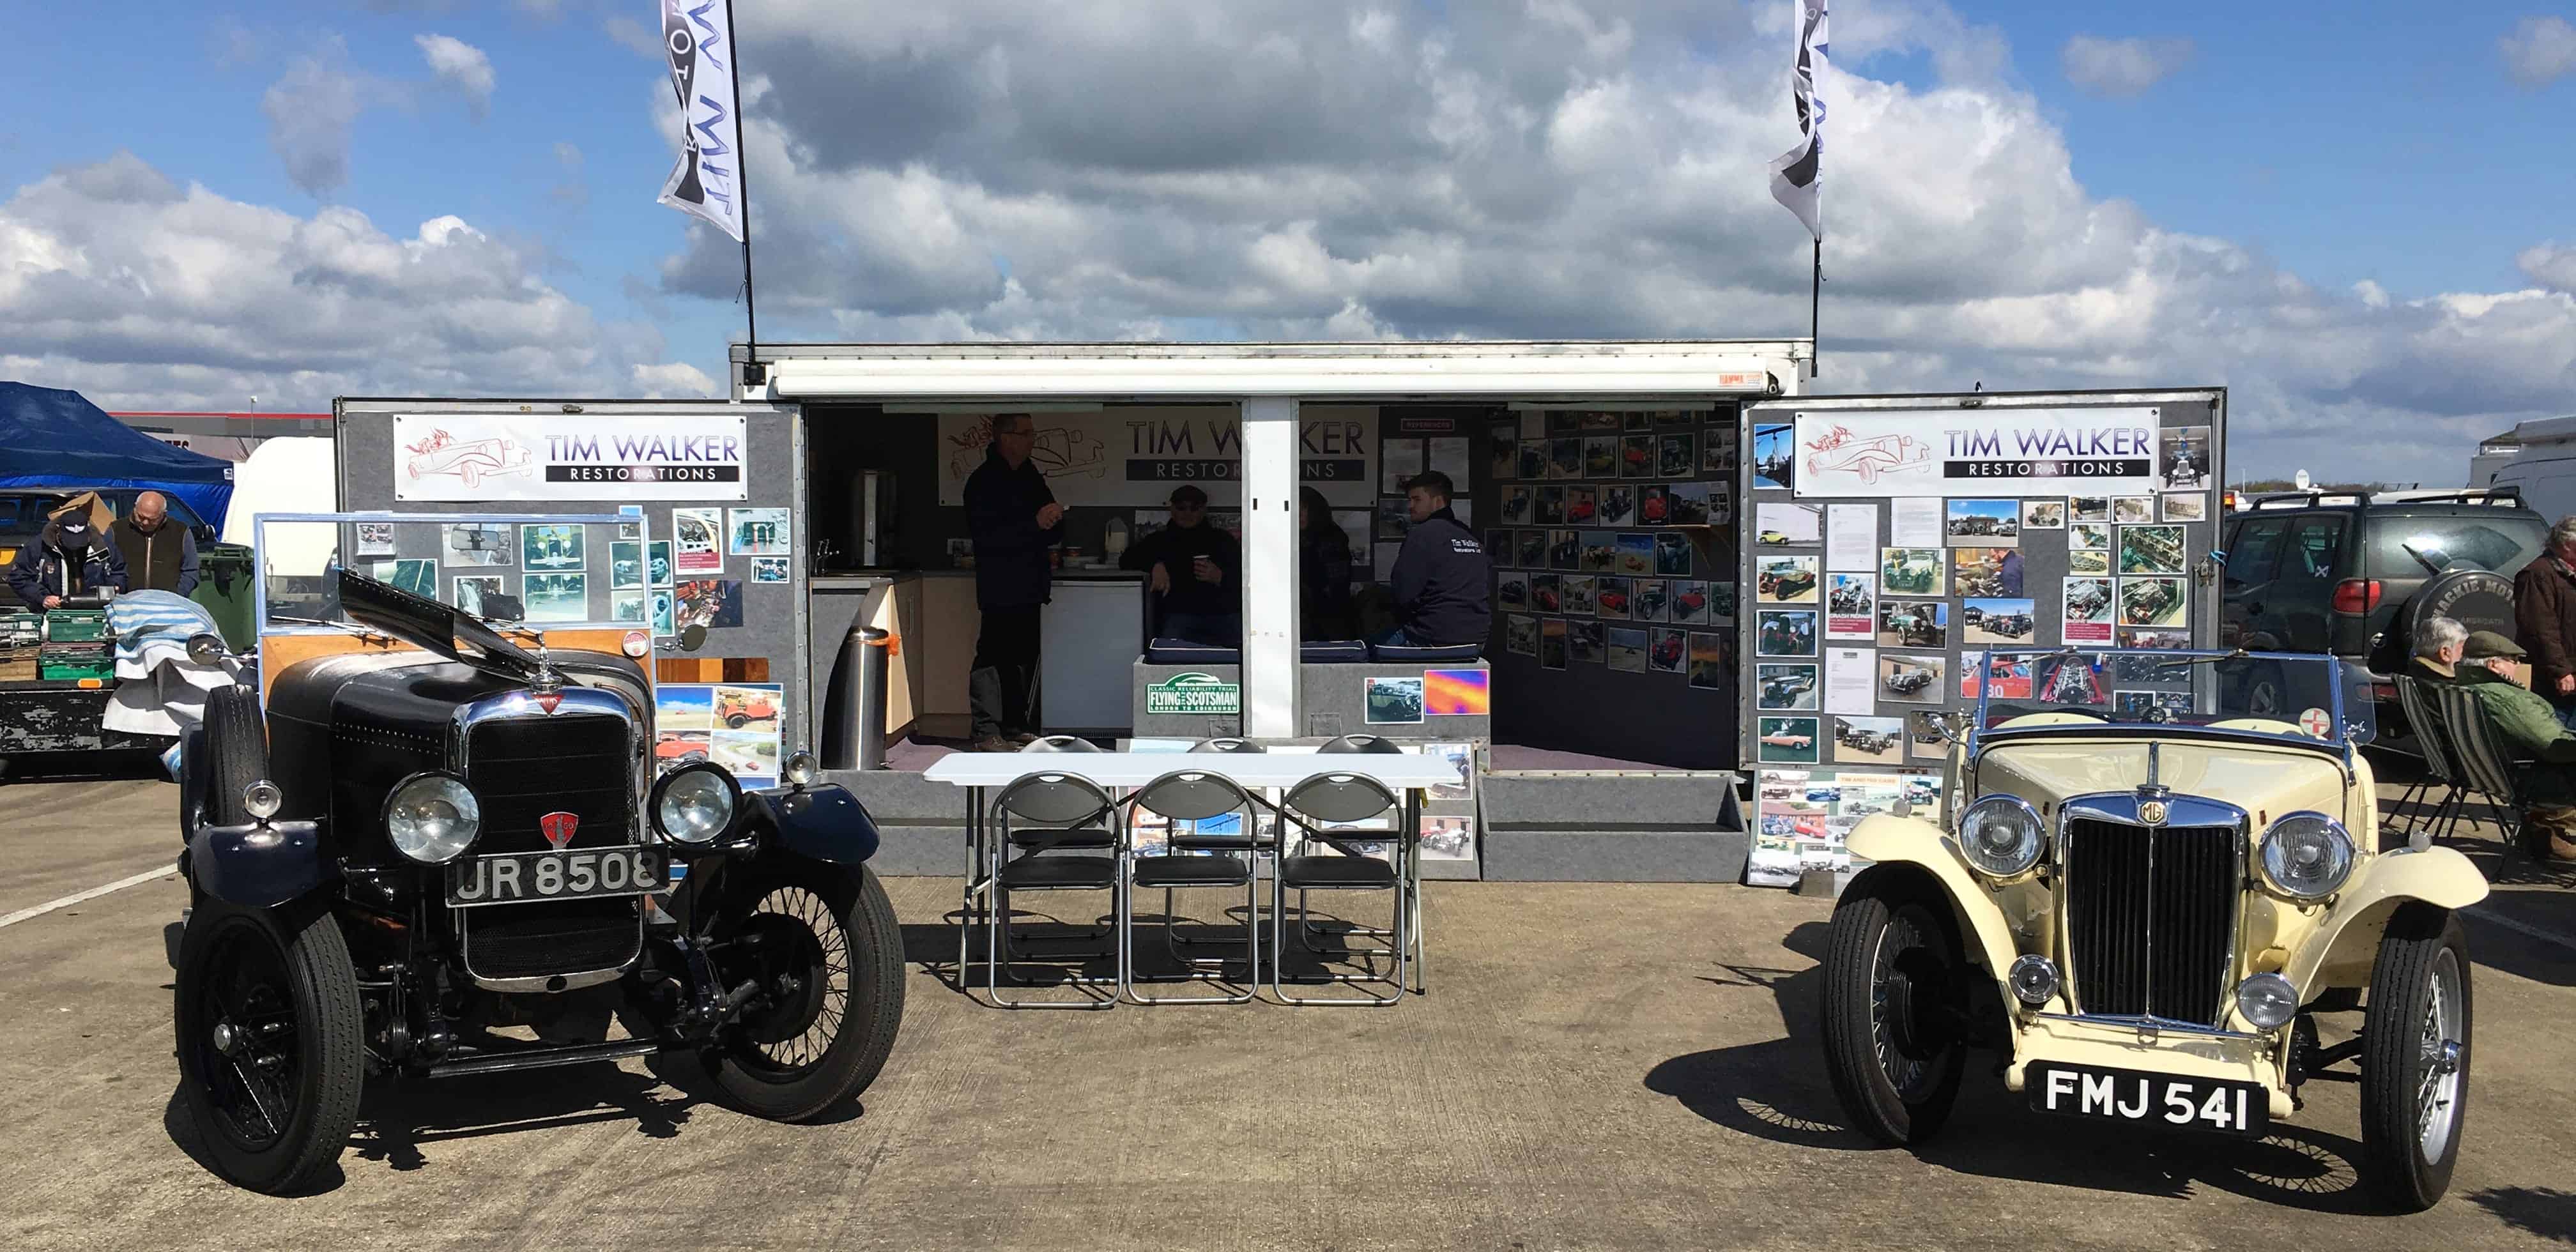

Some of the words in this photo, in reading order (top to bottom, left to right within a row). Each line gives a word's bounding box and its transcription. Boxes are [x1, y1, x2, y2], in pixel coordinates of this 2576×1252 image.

[544, 435, 601, 461] TIM
[611, 434, 739, 462] WALKER
[1125, 420, 1193, 455] TIM
[1943, 429, 2002, 457] TIM
[2013, 427, 2151, 457] WALKER
[570, 468, 716, 480] RESTORATIONS
[1968, 461, 2124, 476] RESTORATIONS
[1150, 692, 1181, 706] FLYING
[1186, 692, 1237, 706] SCOTSMAN
[2142, 803, 2162, 821] MG
[456, 859, 523, 899] JR
[535, 852, 659, 895] 8508
[2046, 1069, 2149, 1118] FMJ
[2163, 1082, 2247, 1131] 541
